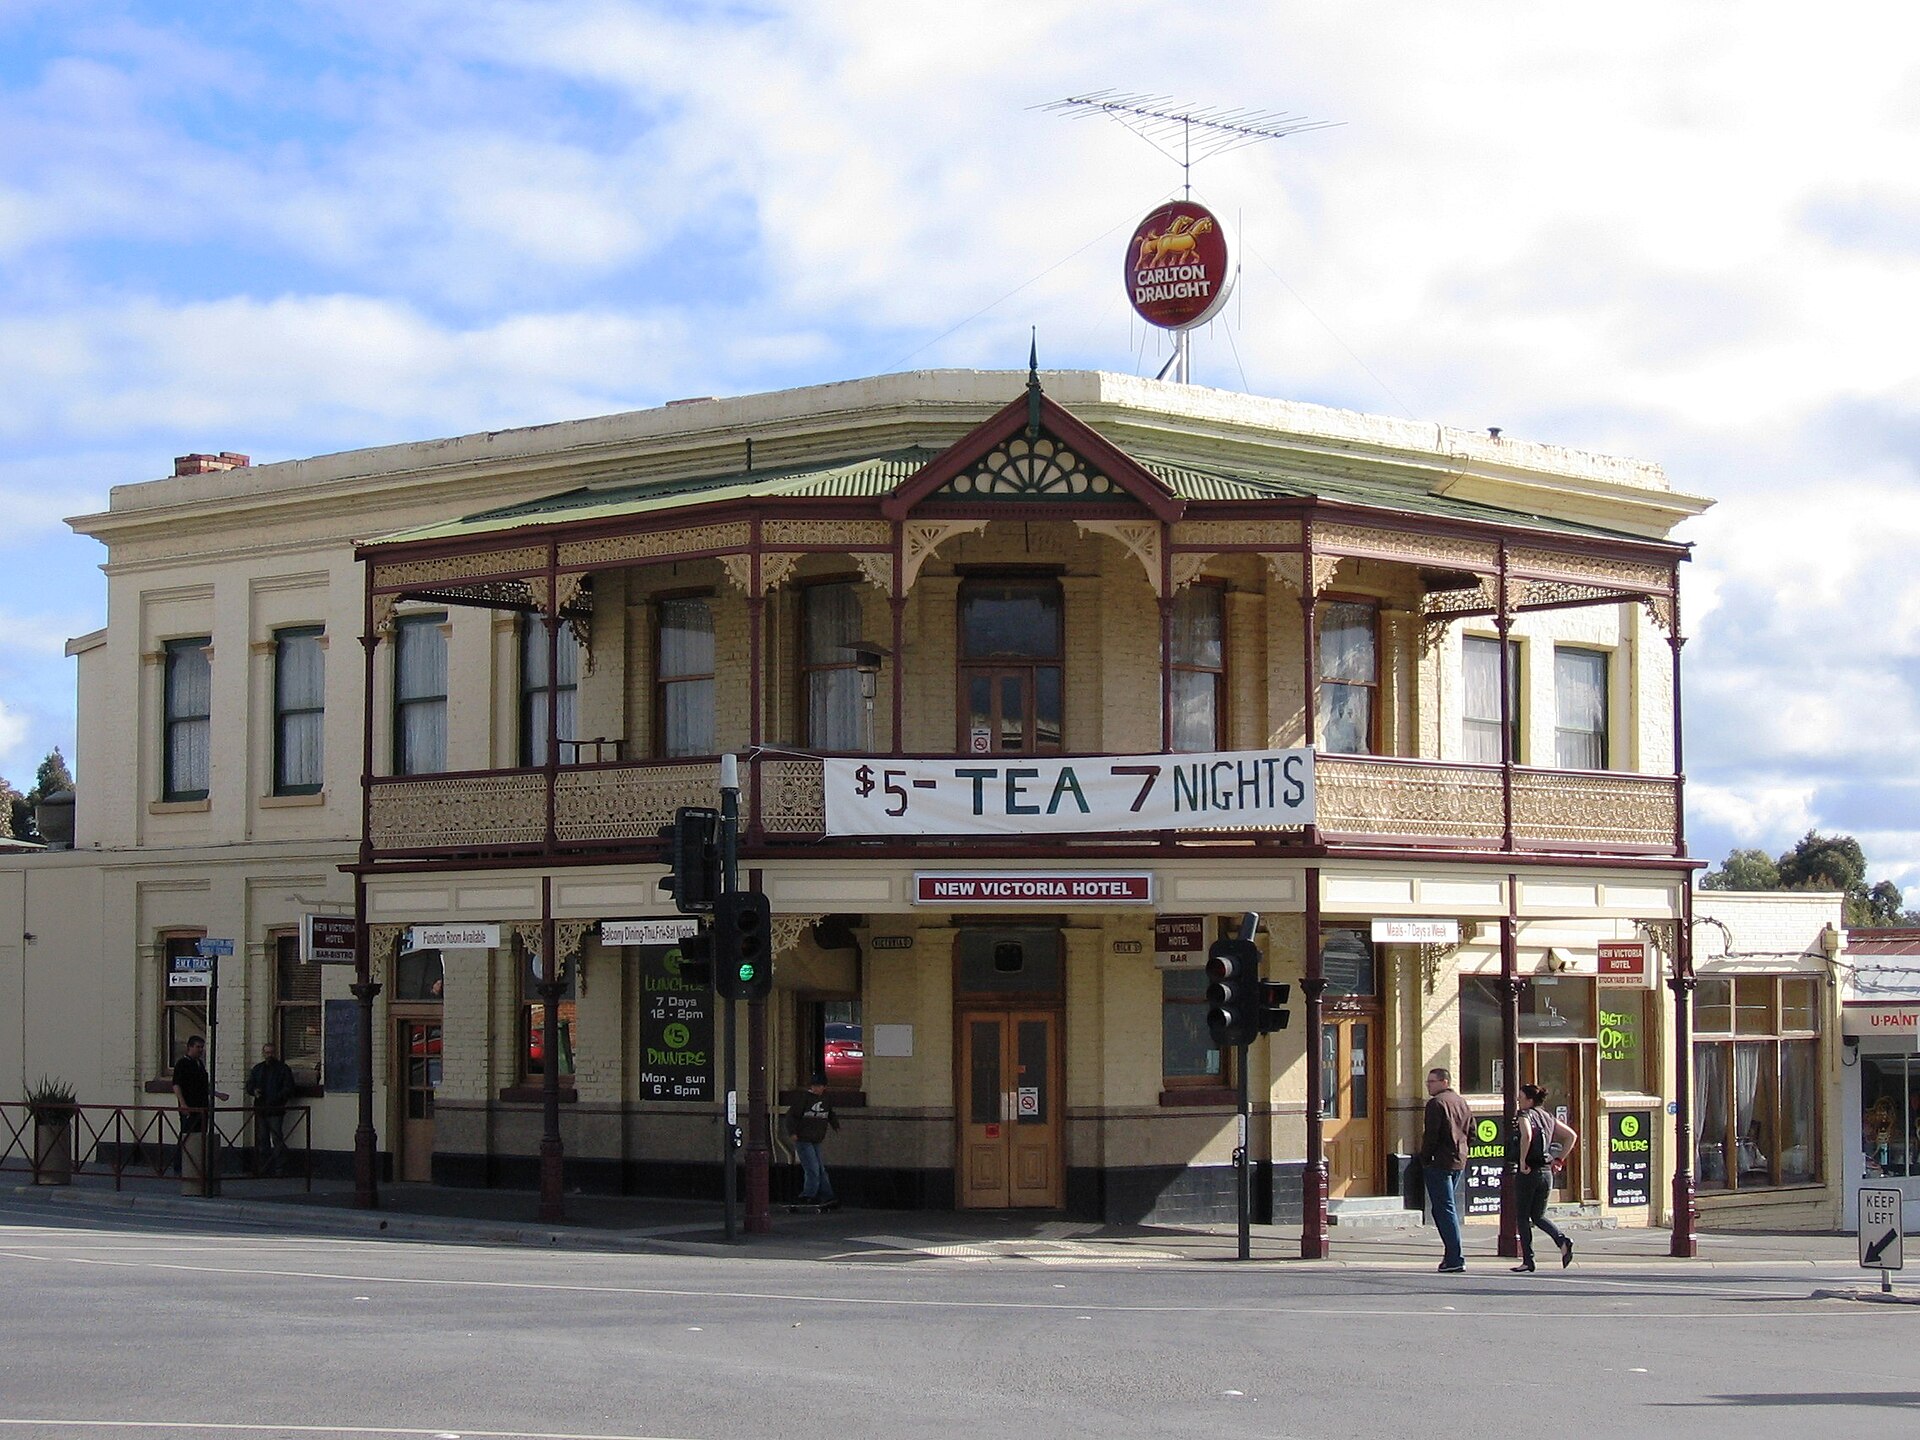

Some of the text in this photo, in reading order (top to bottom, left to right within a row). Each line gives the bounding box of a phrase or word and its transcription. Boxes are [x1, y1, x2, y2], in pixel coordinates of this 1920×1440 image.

[1137, 265, 1205, 286] CARLTON
[1135, 281, 1210, 304] DRAUGHT
[955, 766, 1091, 816] TEA
[1110, 766, 1161, 812] 7
[1173, 756, 1305, 812] NIGHTS
[934, 882, 1132, 896] NEW VICTORIA HOTEL
[314, 923, 327, 931] NEW
[1156, 923, 1201, 933] NEW VICTORIA
[1387, 922, 1404, 937] Meals
[1412, 923, 1426, 940] Days
[1431, 924, 1446, 937] Week
[325, 935, 344, 943] HOTEL
[423, 931, 445, 944] Function
[446, 931, 462, 944] Room
[462, 930, 486, 944] Available
[601, 927, 624, 943] Balcony
[1168, 936, 1189, 946] HOTEL
[1170, 954, 1187, 962] BAR
[1600, 949, 1642, 957] NEW VICTORIA
[1610, 960, 1631, 969] HOTEL
[656, 996, 698, 1009] 7 Days
[650, 1009, 665, 1019] 12
[677, 1009, 704, 1021] 2pm
[647, 1047, 707, 1067] DINNERS
[641, 1072, 667, 1083] Mon
[685, 1075, 706, 1084] sun
[653, 1085, 662, 1095] 6
[674, 1085, 700, 1097] 8pm
[1611, 1138, 1648, 1152] DINNERS
[1472, 1166, 1479, 1176] 7
[1467, 1177, 1479, 1187] 12
[1487, 1177, 1501, 1188] 2p
[1866, 1195, 1895, 1208] KEEP
[1868, 1212, 1894, 1225] LEFT
